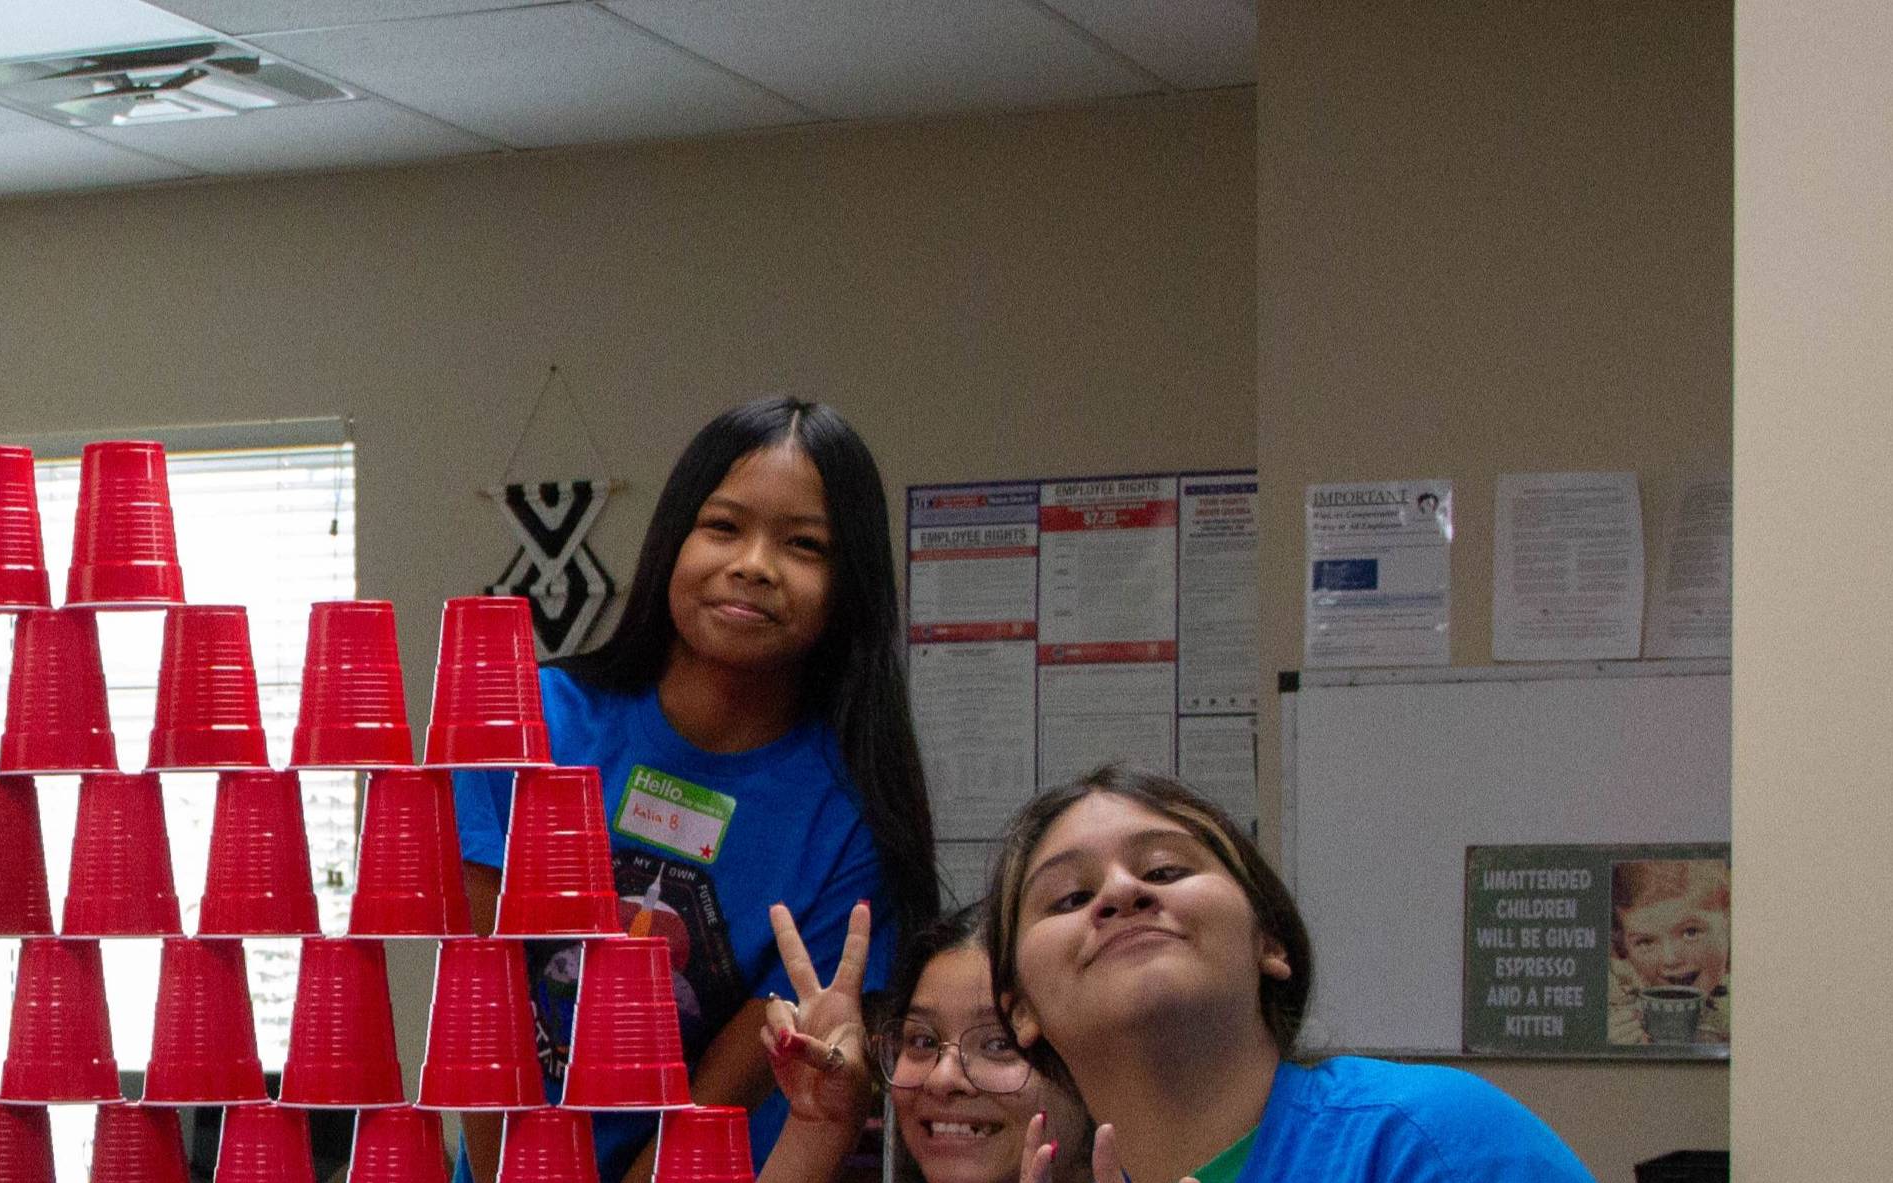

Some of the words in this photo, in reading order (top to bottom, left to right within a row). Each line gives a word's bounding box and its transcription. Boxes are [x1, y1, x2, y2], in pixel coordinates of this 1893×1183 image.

[1055, 482, 1115, 496] EMPLOYEE
[1118, 480, 1159, 493] RIGHTS
[1312, 490, 1409, 506] IMPORTANT
[920, 530, 981, 544] EMPLOYEE
[984, 528, 1027, 543] RIGHTS
[634, 770, 683, 801] Hello
[1484, 869, 1592, 890] UNATTENDED
[633, 857, 651, 869] MY
[668, 867, 696, 881] OWN
[699, 884, 718, 925] FUTURE
[1496, 898, 1577, 919] CHILDREN
[1477, 928, 1515, 949] WILL
[1520, 928, 1541, 948] BE
[1545, 928, 1596, 949] GIVEN
[1495, 957, 1576, 977] ESPRESSO
[1486, 986, 1521, 1007] AND
[1526, 987, 1538, 1007] A
[1543, 986, 1584, 1007] FREE
[1505, 1015, 1564, 1037] KITTEN
